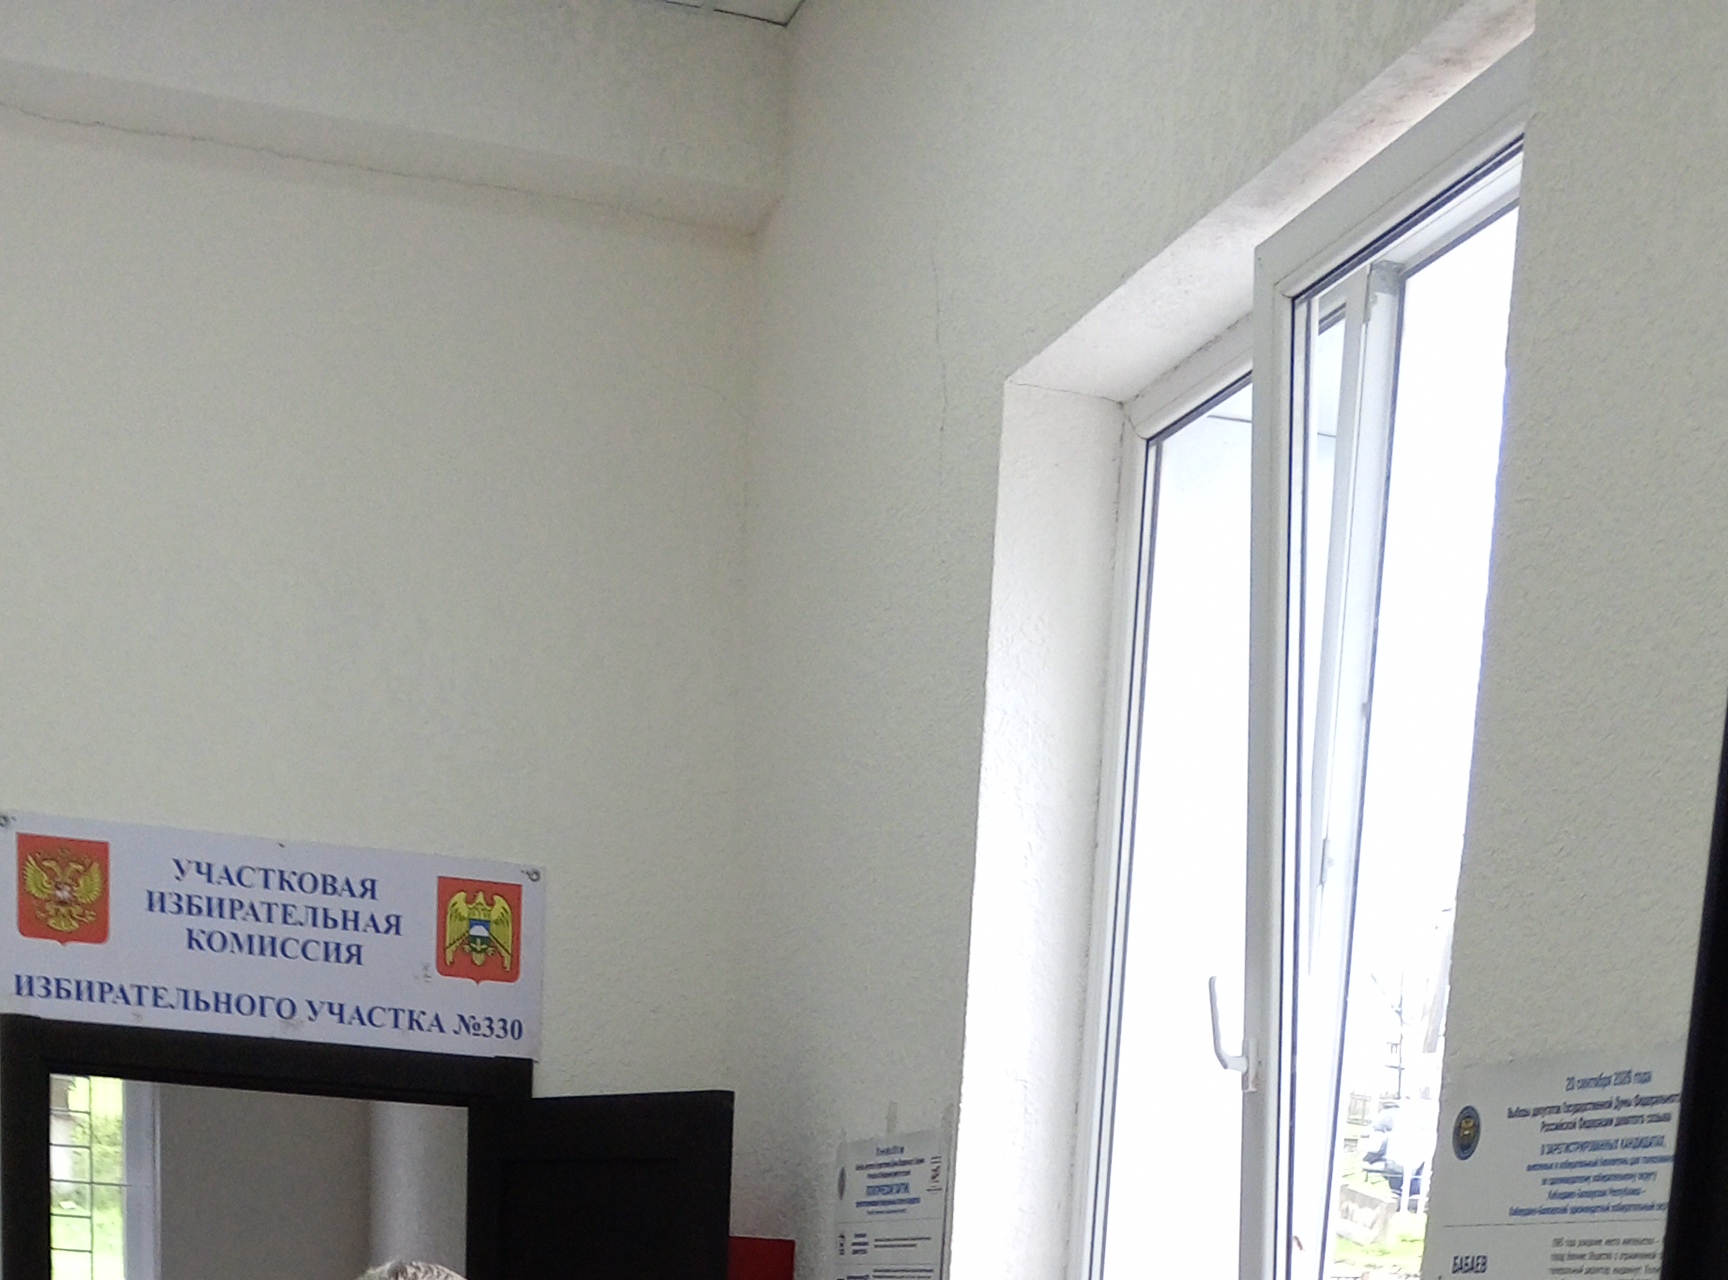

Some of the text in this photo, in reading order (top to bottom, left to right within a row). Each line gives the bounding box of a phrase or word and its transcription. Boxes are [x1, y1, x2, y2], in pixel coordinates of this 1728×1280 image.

[172, 858, 379, 900] УЧАСТКОВАЯ
[145, 889, 403, 936] ИЗБИРАТЕЛЬНАЯ
[186, 927, 364, 966] КОМИССИЯ
[14, 974, 524, 1041] ИЗБИРАТЕЛЬНОГО УЧАСТКА №330
[1452, 1255, 1487, 1274] БАБАЕВ
